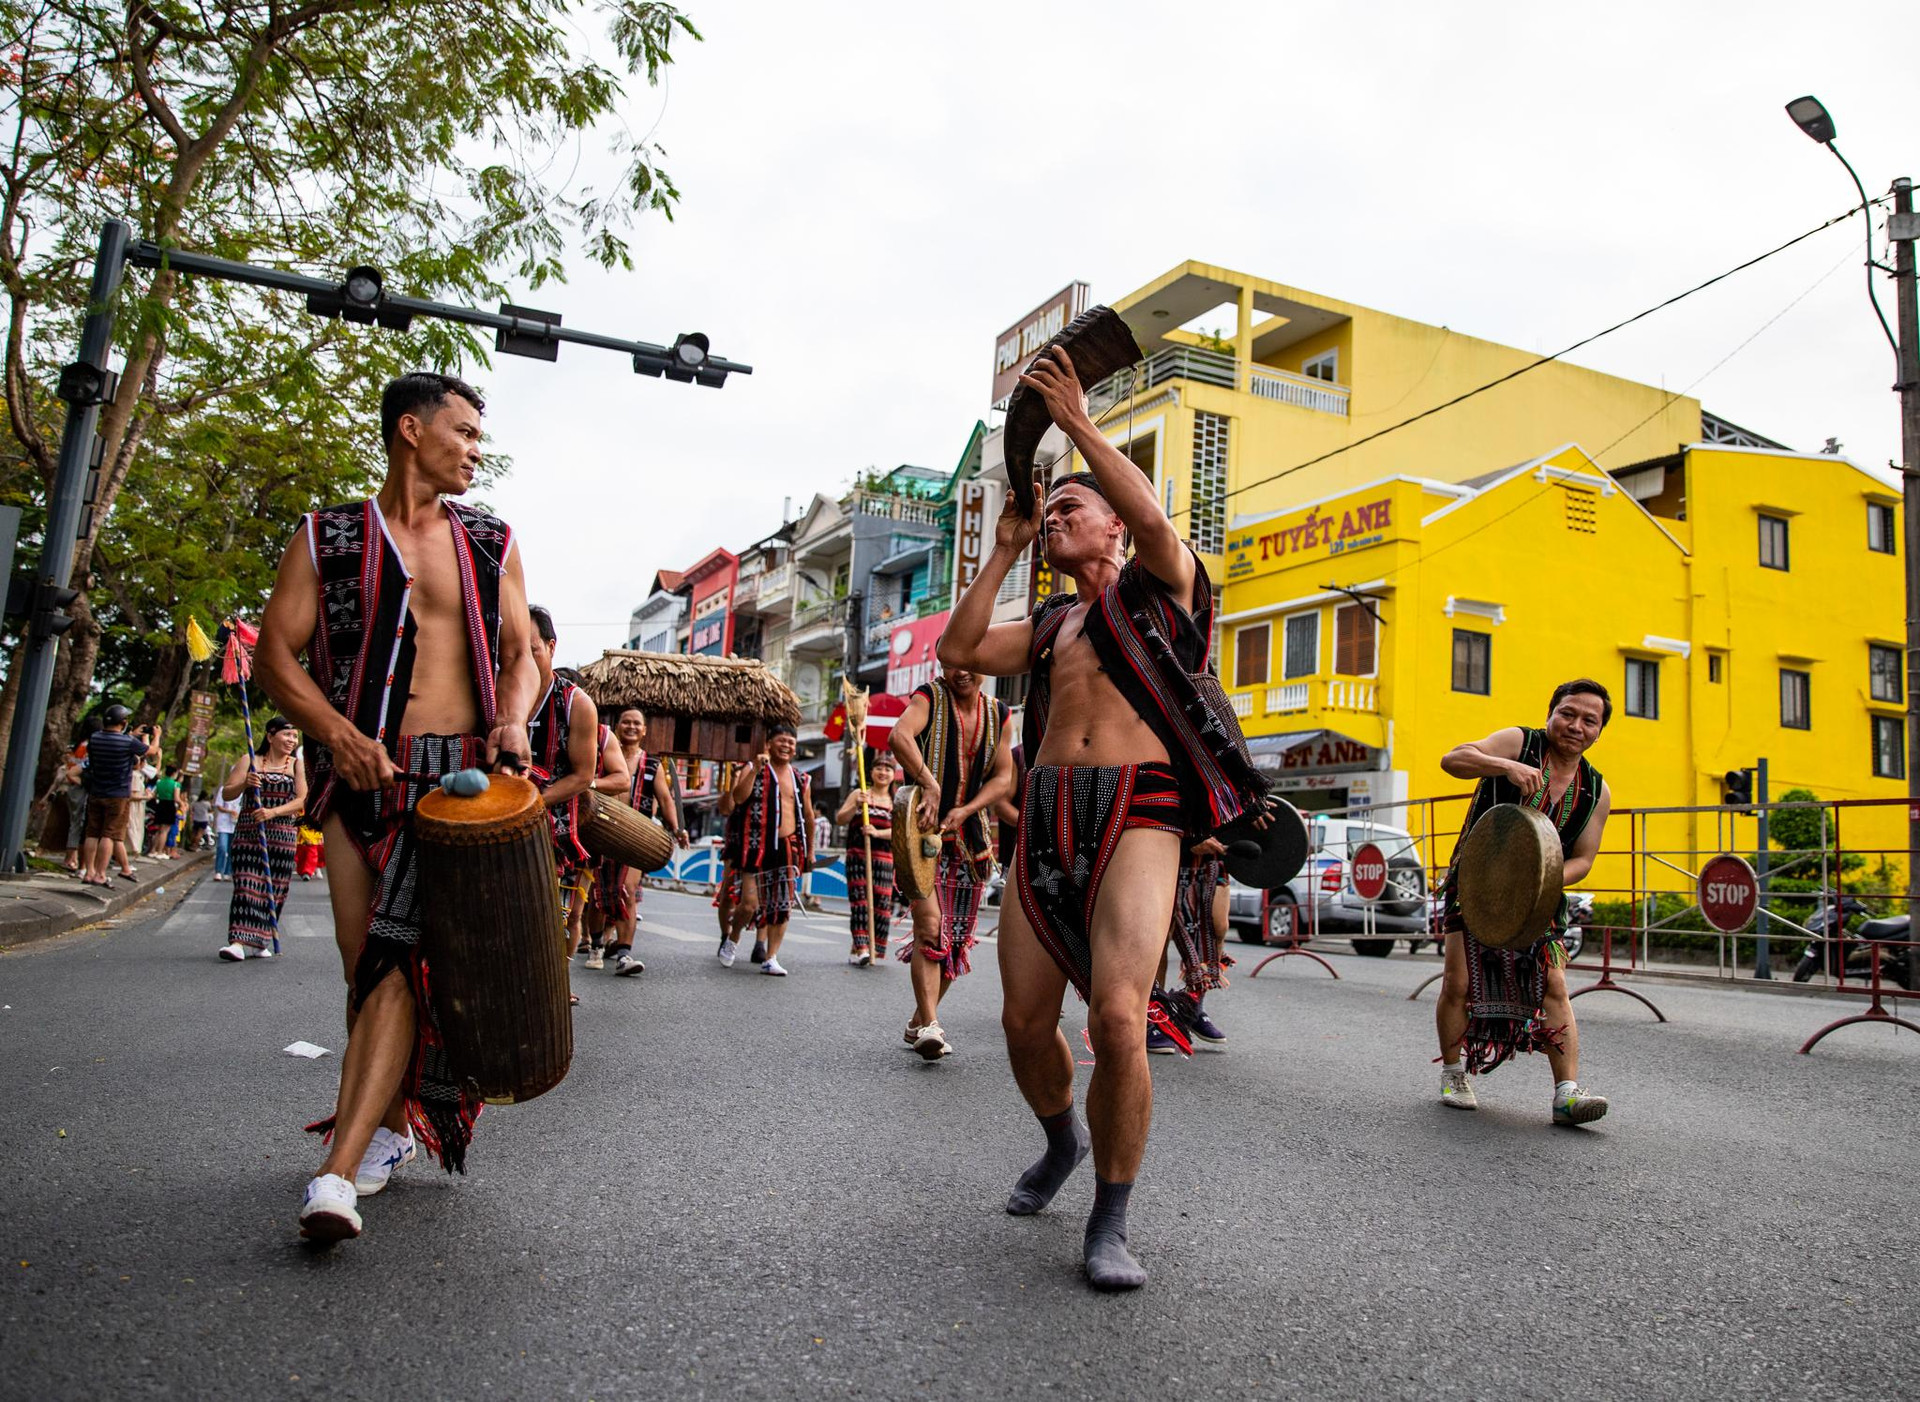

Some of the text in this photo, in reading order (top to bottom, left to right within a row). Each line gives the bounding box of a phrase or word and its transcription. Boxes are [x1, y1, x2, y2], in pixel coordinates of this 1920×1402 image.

[1259, 498, 1392, 561] TUYẾT ANH
[1317, 741, 1368, 766] ANH
[1355, 864, 1383, 880] STOP
[1706, 882, 1750, 905] STOP
